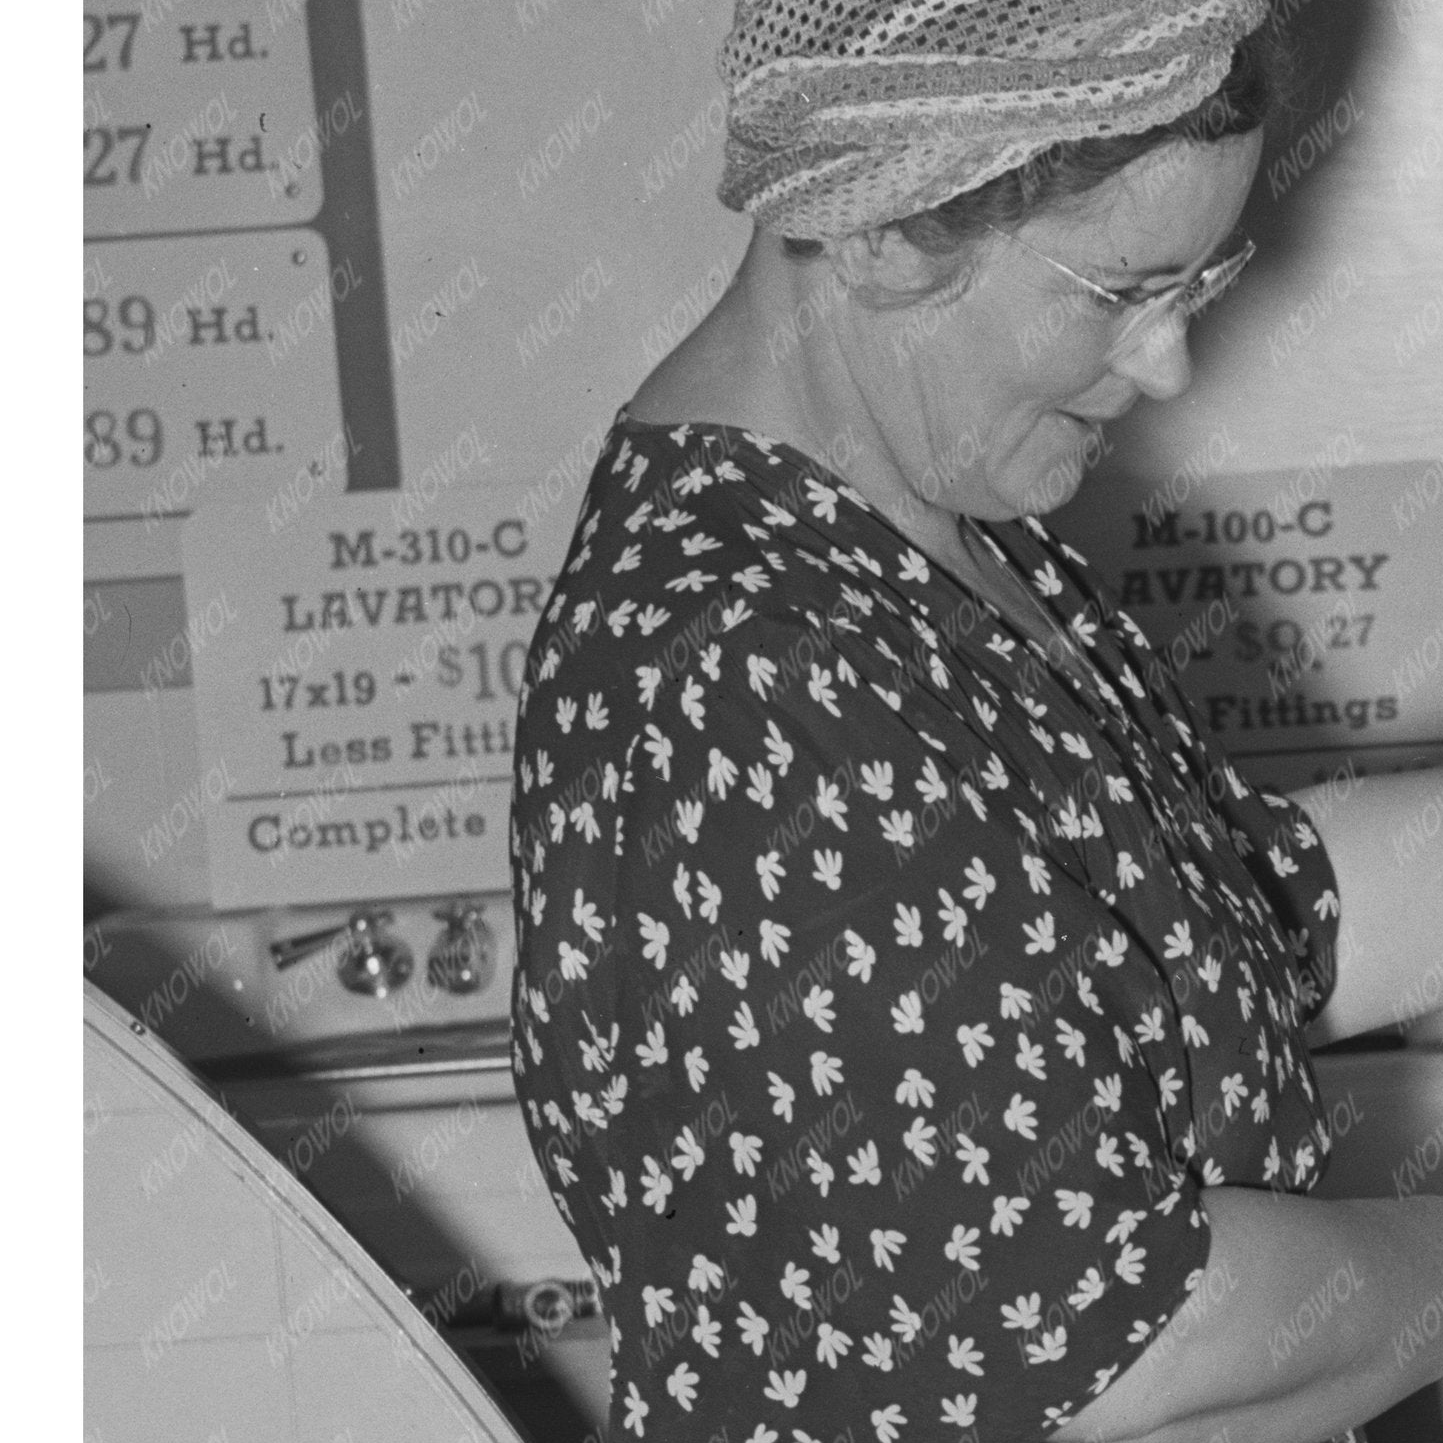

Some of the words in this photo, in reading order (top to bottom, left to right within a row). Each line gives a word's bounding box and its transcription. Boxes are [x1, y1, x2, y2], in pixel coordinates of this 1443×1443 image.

[83, 12, 143, 73] 27
[178, 22, 269, 63] Hd.
[83, 124, 151, 188] 27
[191, 135, 281, 177] Hd.
[83, 294, 157, 359] 89
[187, 304, 274, 346] Hd.
[83, 407, 164, 470] 89
[194, 416, 285, 458] Hd.
[328, 519, 529, 571] M-310-C
[1132, 500, 1333, 549] M-100-C
[281, 575, 557, 634] LAVATOR
[259, 670, 377, 711] 17x19
[1206, 692, 1398, 732] Fittings
[281, 730, 392, 770] Less
[248, 803, 486, 854] Complete
